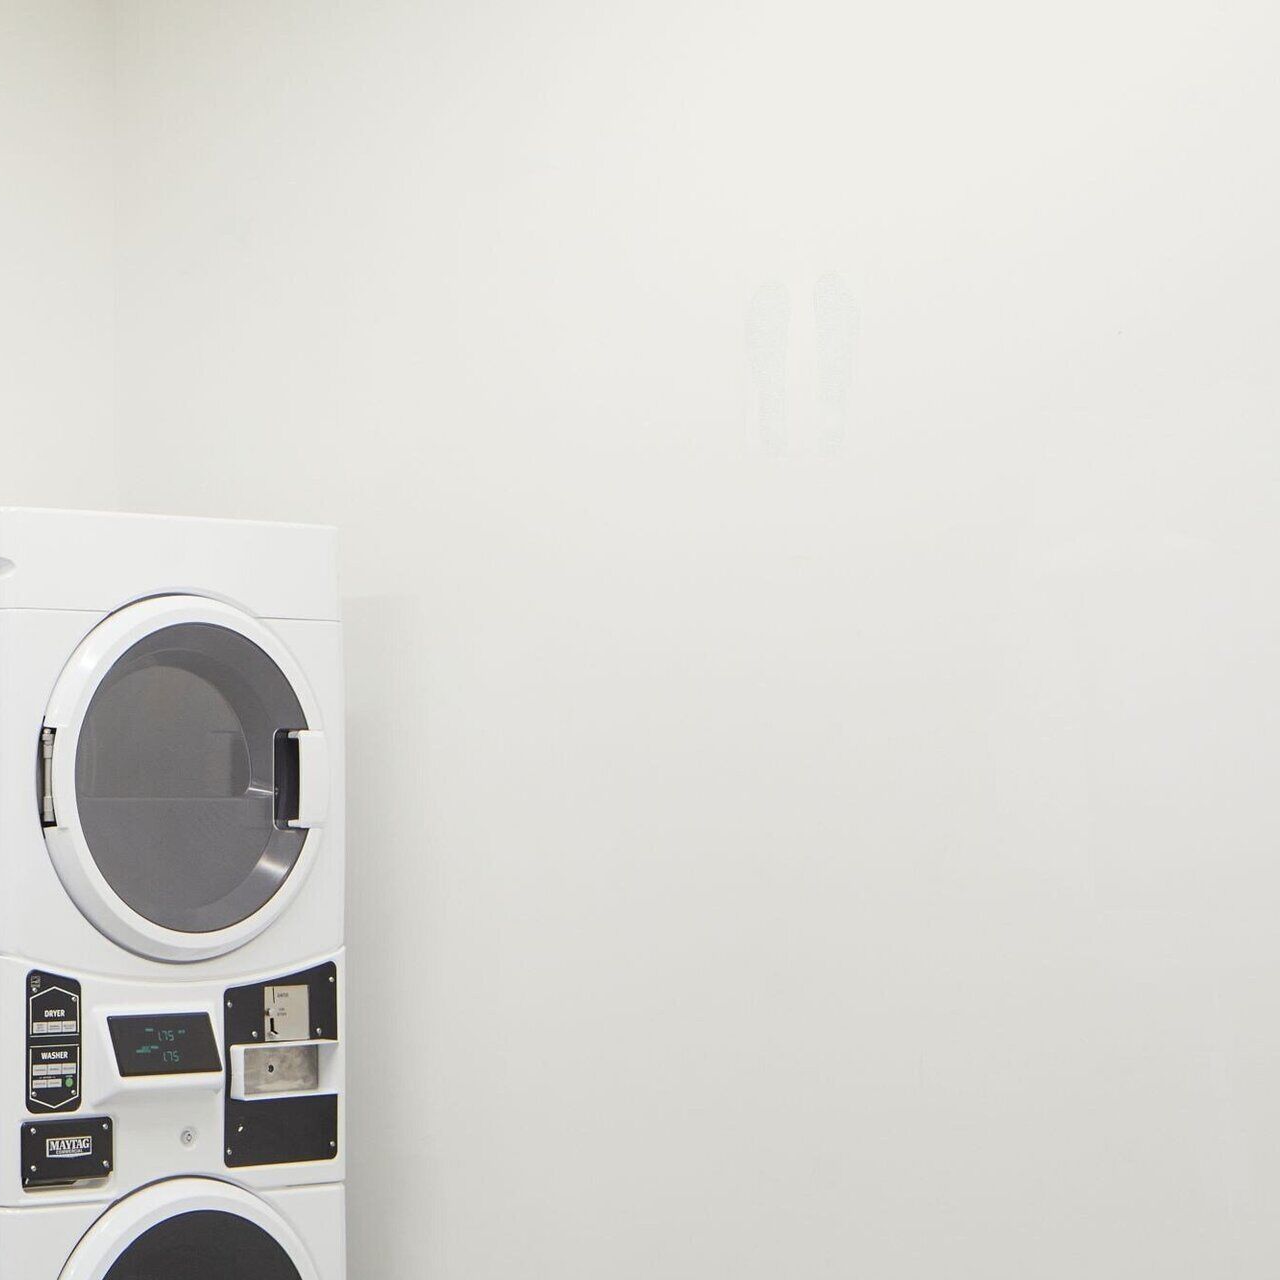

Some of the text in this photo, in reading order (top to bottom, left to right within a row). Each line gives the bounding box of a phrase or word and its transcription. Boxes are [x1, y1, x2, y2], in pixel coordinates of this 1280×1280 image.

[44, 1009, 65, 1018] DRYER
[41, 1051, 68, 1060] WASHER
[50, 1138, 90, 1151] MAYTAG
